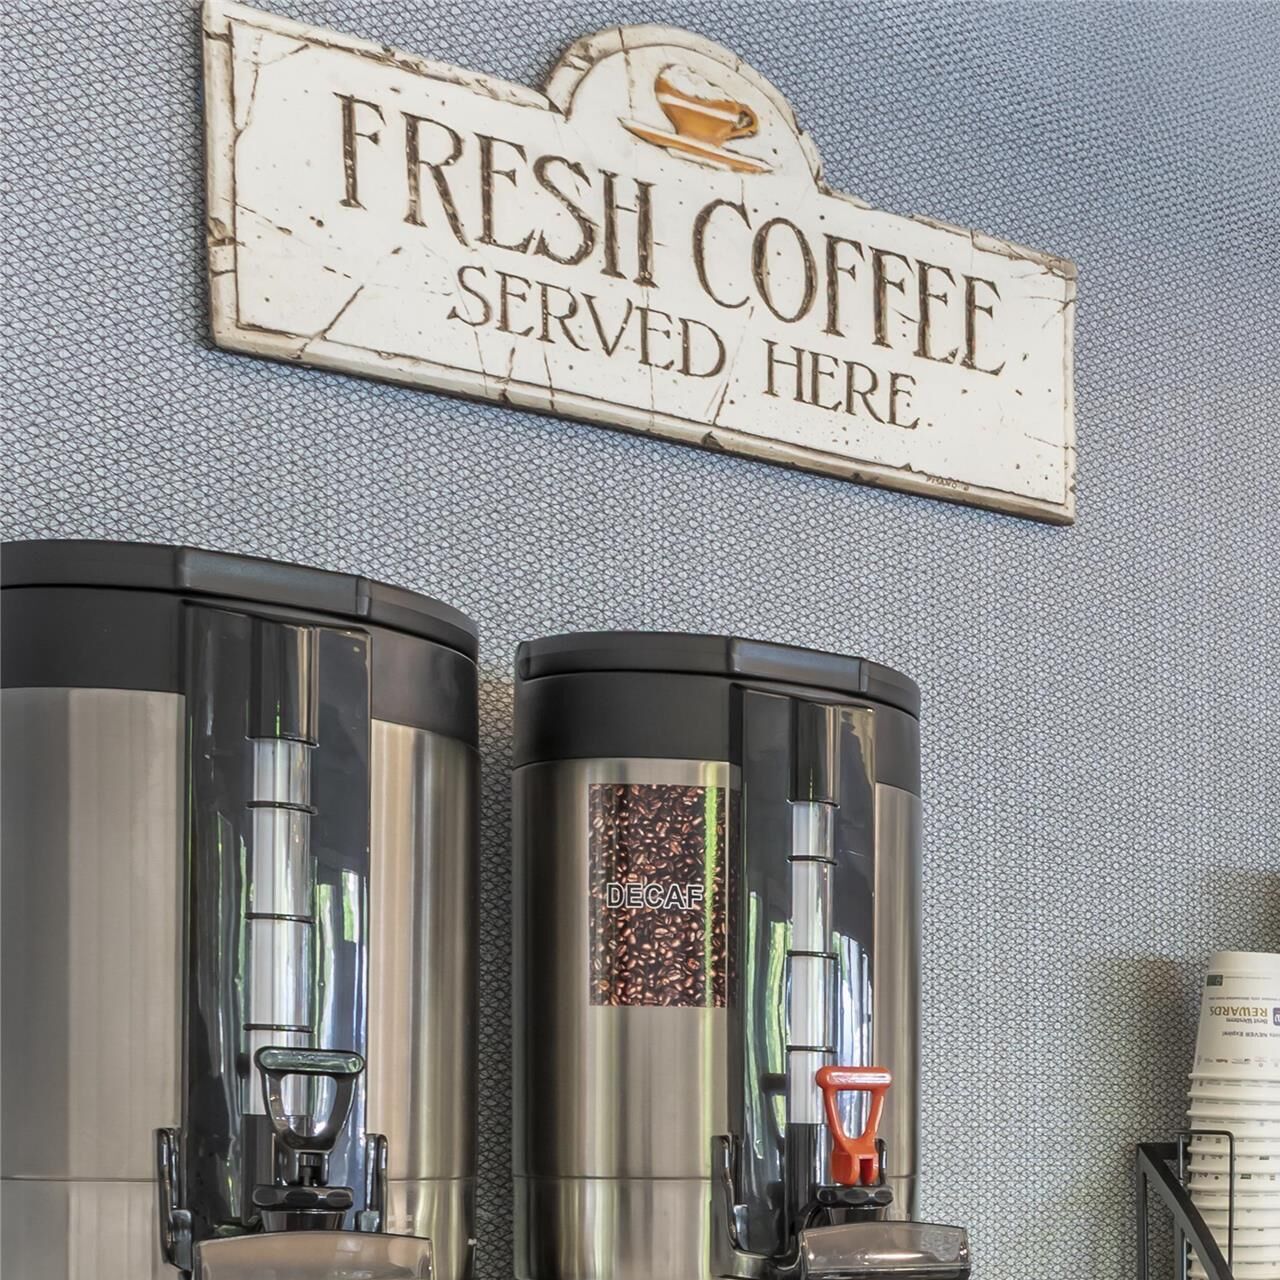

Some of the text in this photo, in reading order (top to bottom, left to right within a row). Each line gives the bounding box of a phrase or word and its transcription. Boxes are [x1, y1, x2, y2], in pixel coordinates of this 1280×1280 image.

[333, 92, 1006, 376] FRESH COFFEE
[446, 265, 920, 431] SERVED HERE
[606, 882, 704, 910] DECAF
[1209, 1006, 1268, 1017] REWARDS
